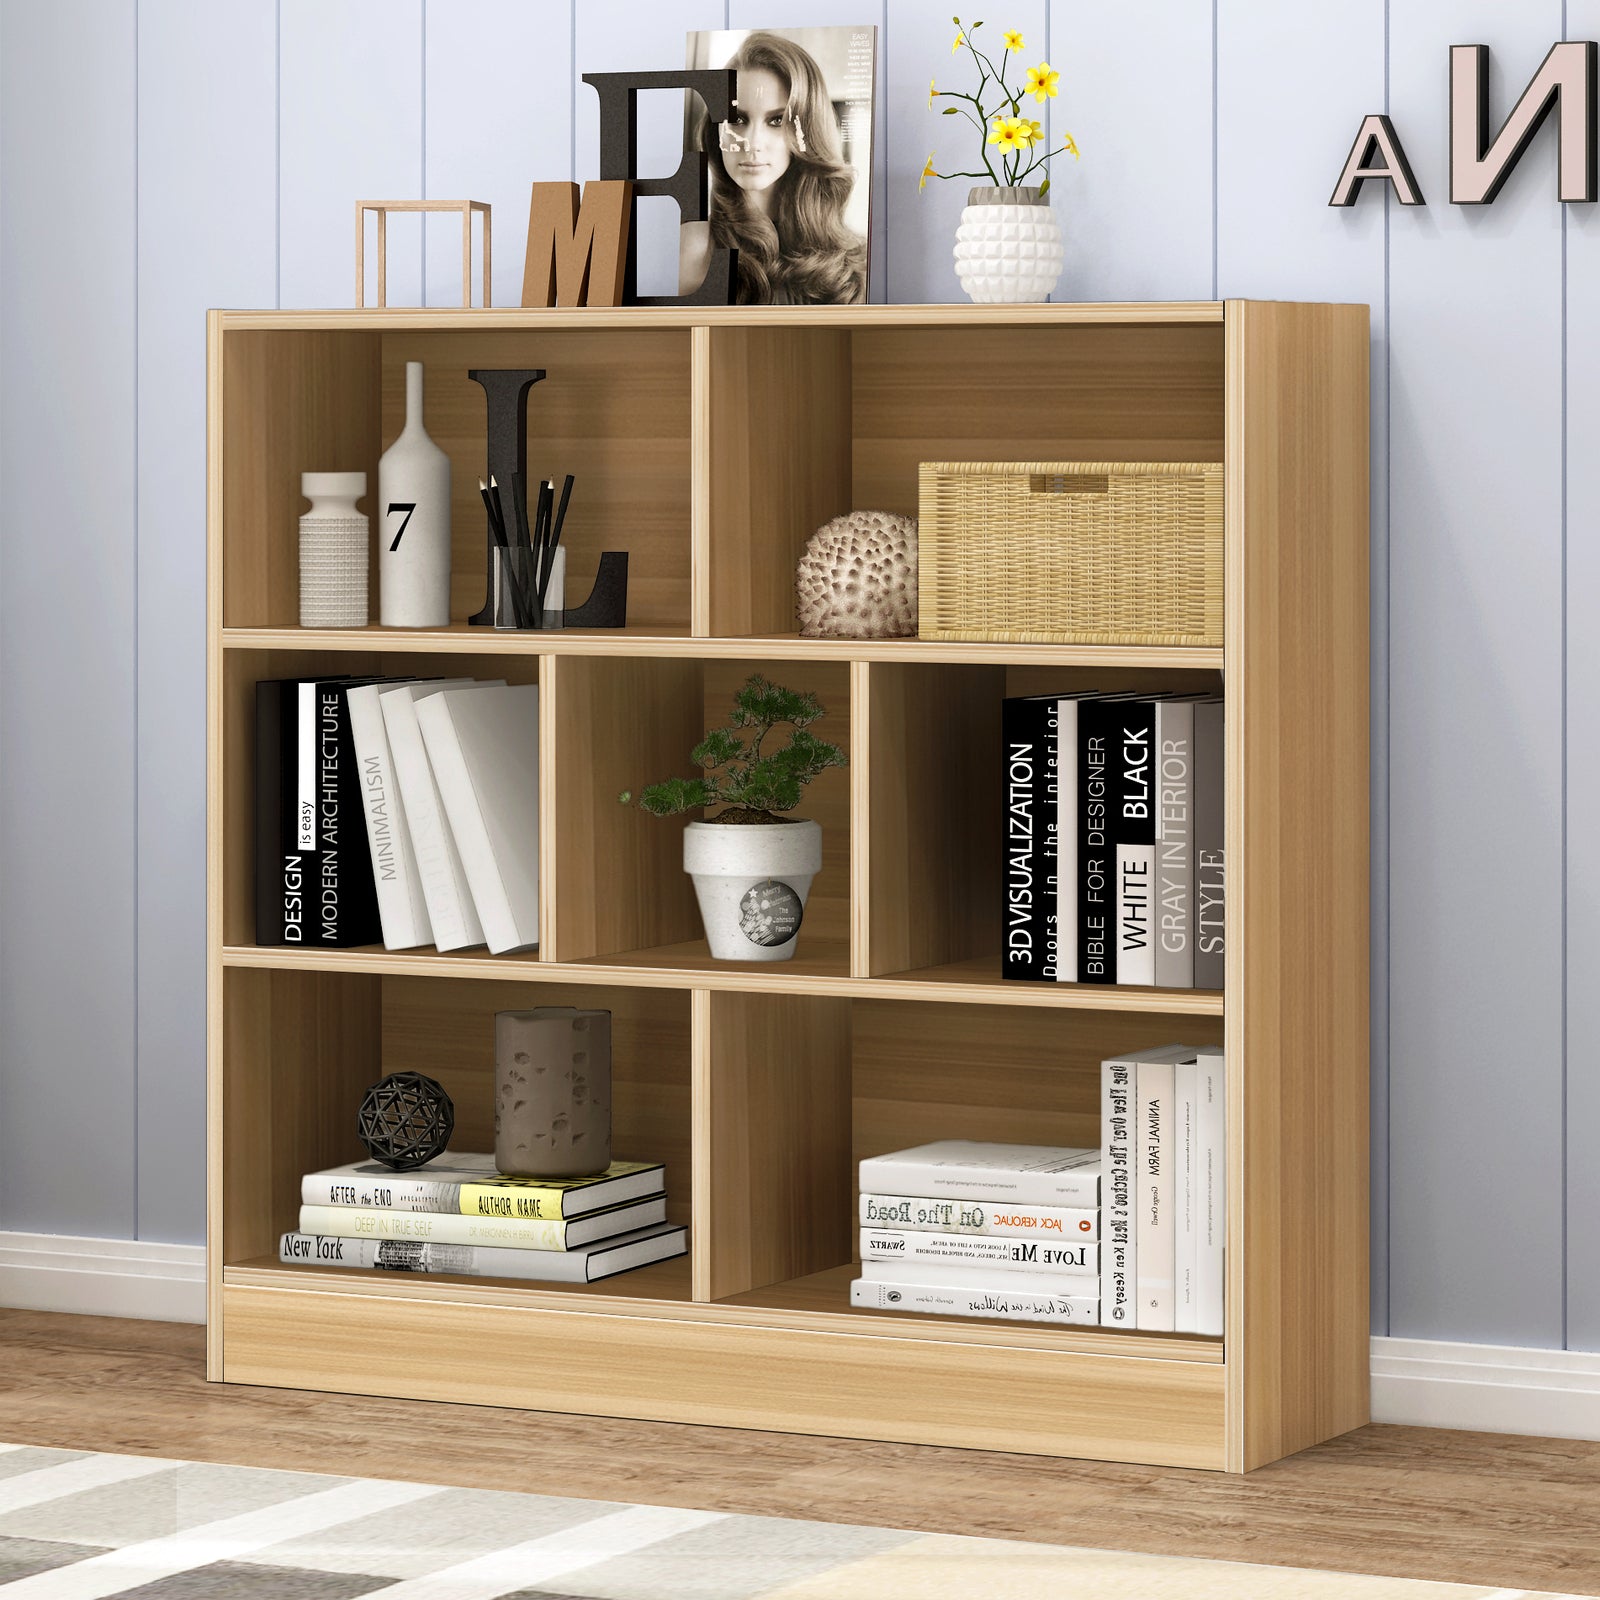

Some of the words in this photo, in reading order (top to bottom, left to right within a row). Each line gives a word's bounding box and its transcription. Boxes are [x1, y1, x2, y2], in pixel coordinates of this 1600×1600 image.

[522, 180, 633, 307] M
[386, 503, 416, 552] 7
[468, 369, 629, 629] L
[322, 694, 338, 844] ARCHITECTURE
[1044, 706, 1059, 804] interior
[1088, 737, 1105, 846] DESIGNER
[1122, 727, 1148, 818] BLACK
[299, 834, 311, 844] is
[301, 801, 315, 832] easy
[364, 755, 397, 881] MINIMALISM
[1009, 743, 1033, 926] VISUALIZATION
[1043, 823, 1058, 857] the
[1162, 739, 1187, 869] INTERIOR
[285, 856, 302, 942] DESIGN
[322, 851, 338, 940] MODERN
[1043, 875, 1058, 894] in
[1088, 859, 1104, 902] FOR
[1122, 860, 1148, 950] WHITE
[1162, 876, 1186, 953] GRAY
[1199, 850, 1224, 954] STYLE
[1009, 928, 1032, 964] 3D
[1043, 914, 1058, 977] Doors
[1087, 916, 1104, 975] BIBLE
[330, 1184, 356, 1204] AFTER
[360, 1193, 372, 1206] the
[374, 1188, 392, 1207] END
[354, 1216, 376, 1232] DEEP
[378, 1218, 389, 1233] IN
[392, 1218, 412, 1236] TRUE
[414, 1220, 433, 1237] SELF
[478, 1194, 512, 1217] AUTHOR
[517, 1198, 543, 1218] NAME
[284, 1235, 312, 1258] New
[316, 1236, 344, 1260] York
